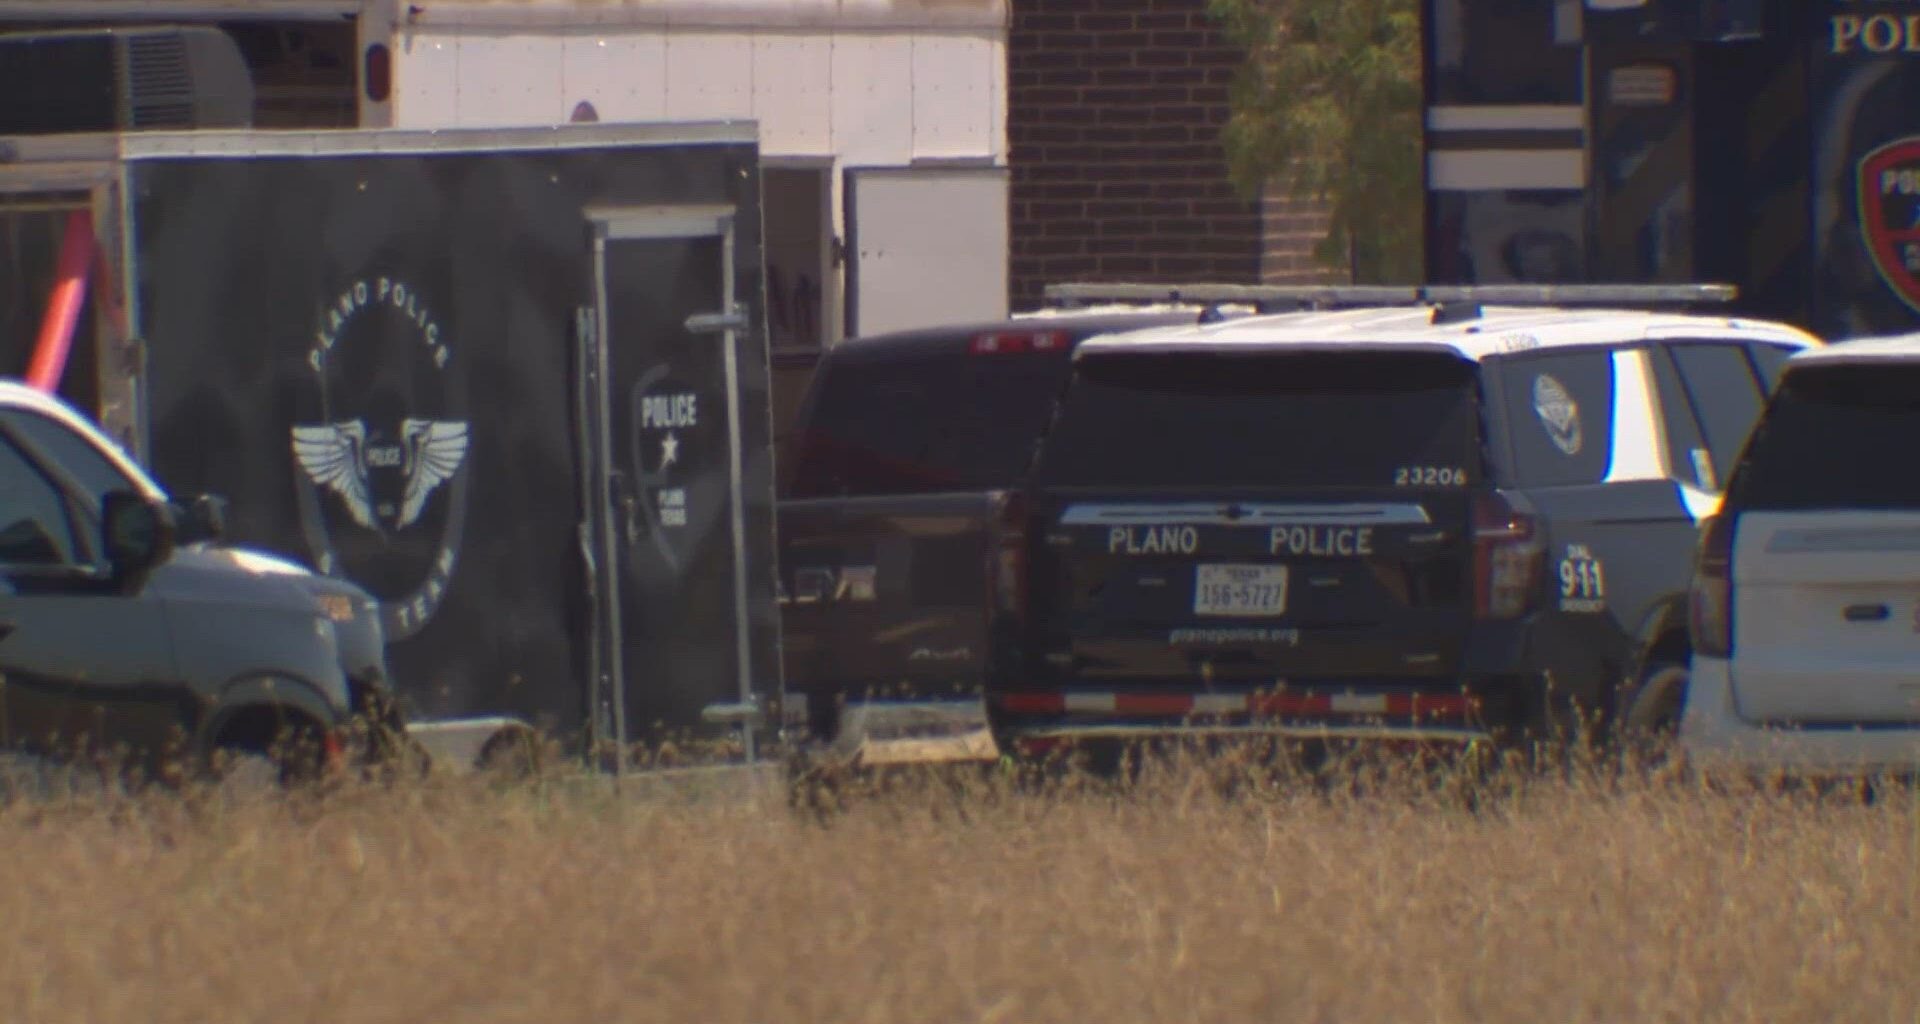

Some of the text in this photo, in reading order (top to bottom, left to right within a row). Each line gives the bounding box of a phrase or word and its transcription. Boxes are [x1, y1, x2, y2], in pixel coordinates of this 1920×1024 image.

[641, 393, 697, 428] POLICE
[1394, 467, 1466, 486] 23206
[1108, 526, 1374, 556] PLANO POLICE
